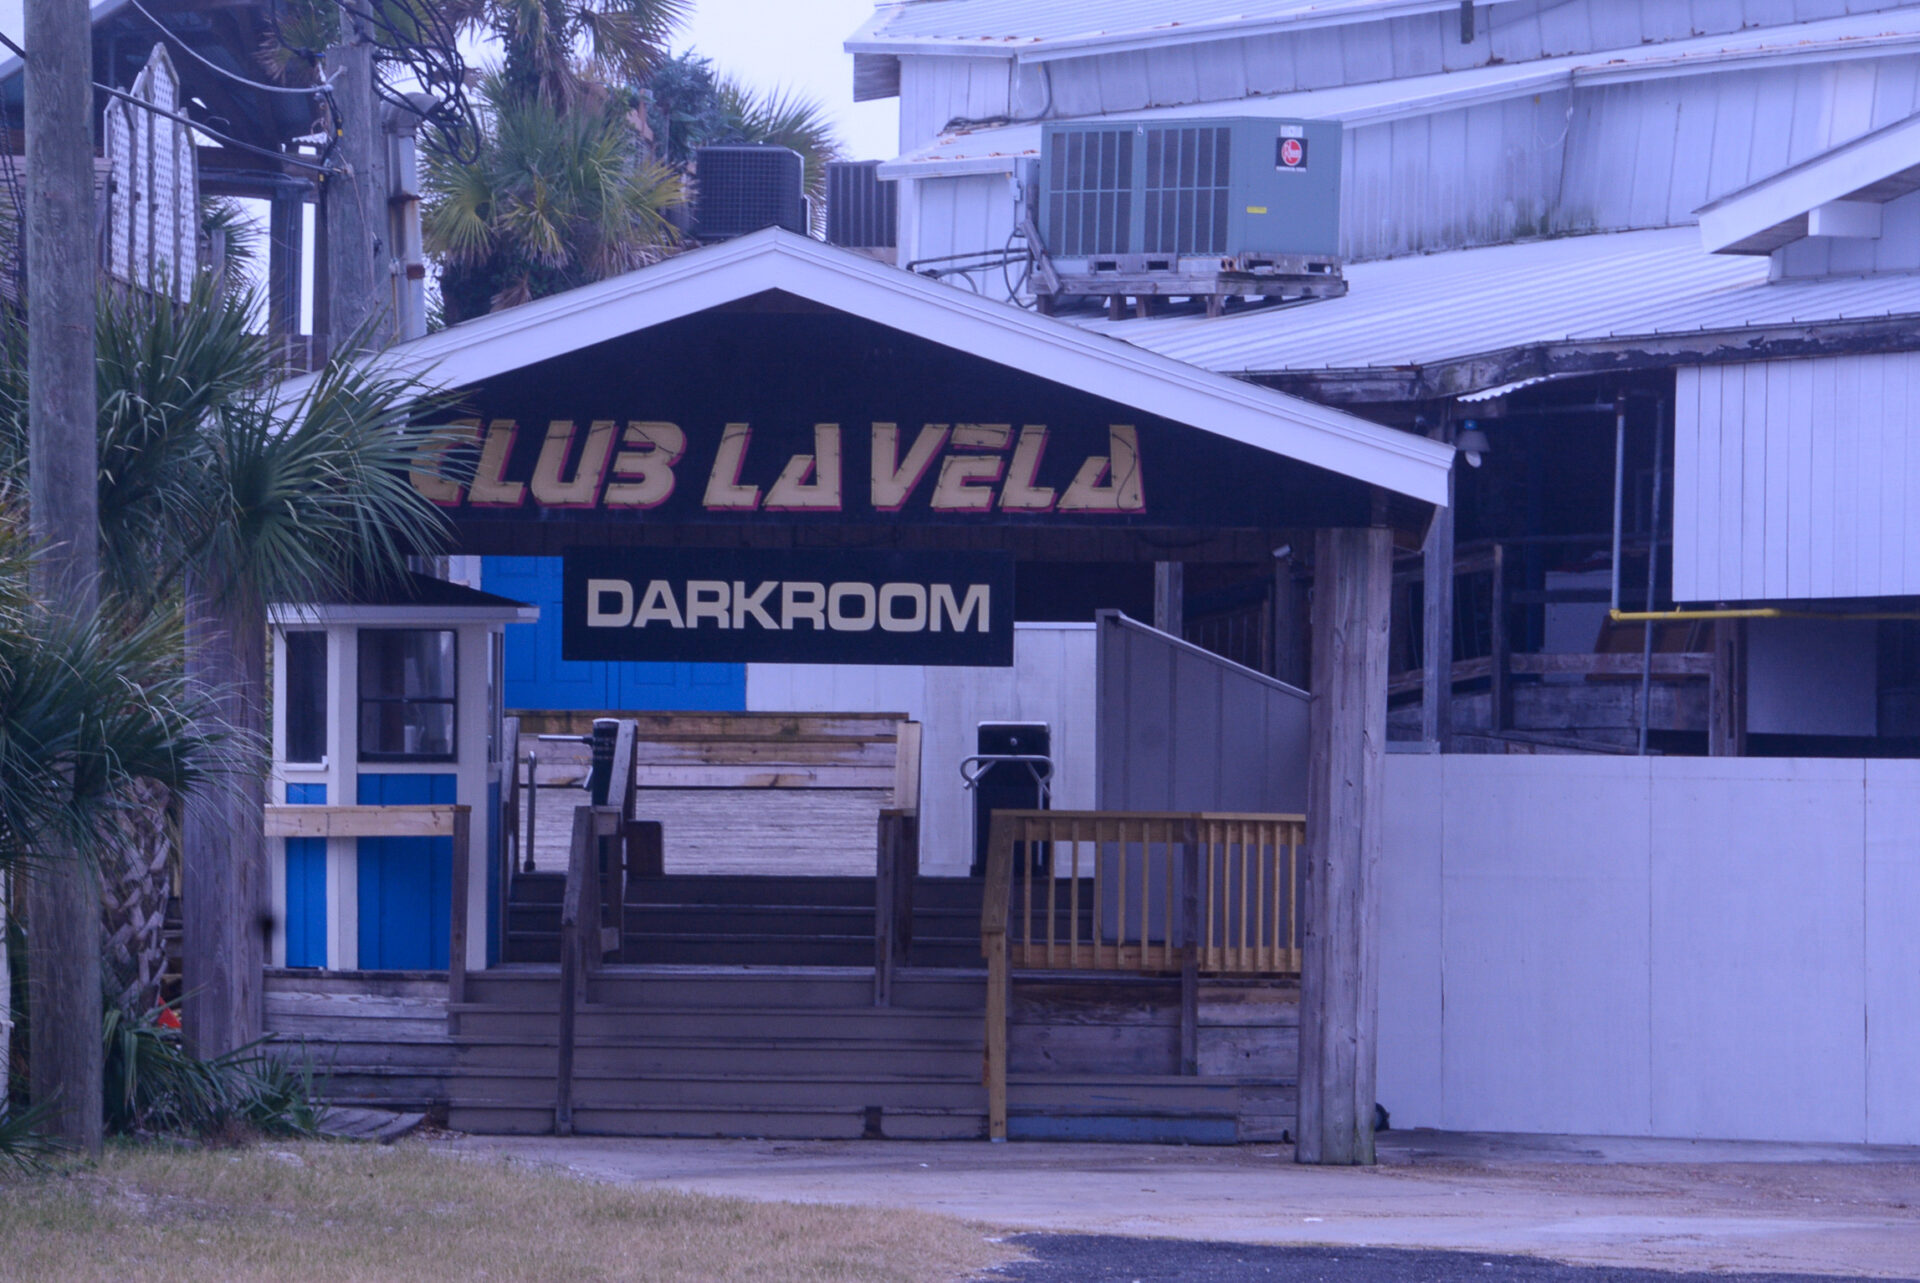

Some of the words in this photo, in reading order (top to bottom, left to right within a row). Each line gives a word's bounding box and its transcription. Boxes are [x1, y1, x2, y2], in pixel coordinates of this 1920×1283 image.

[409, 419, 686, 509] CLUB
[703, 422, 842, 511] LA
[871, 421, 1147, 513] VELA
[587, 578, 990, 633] DARKROOM
